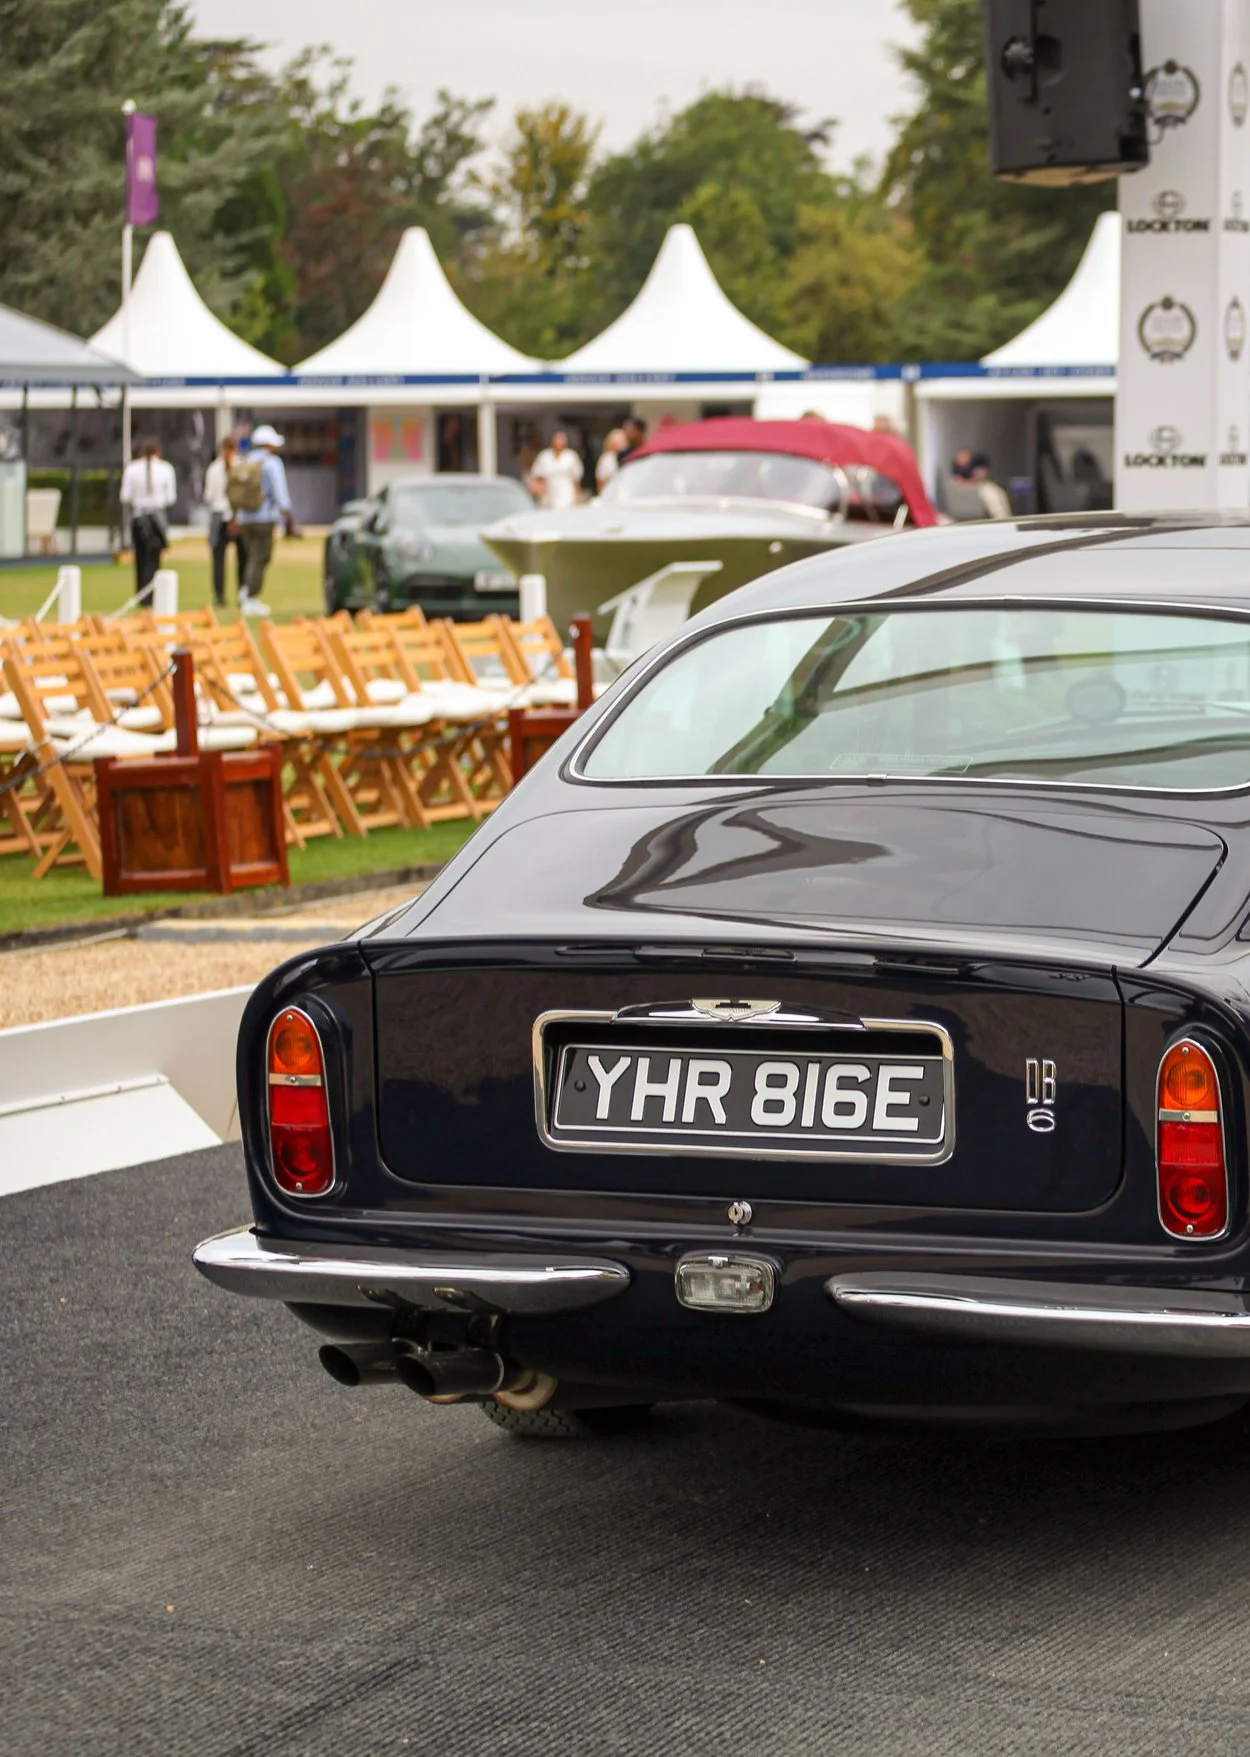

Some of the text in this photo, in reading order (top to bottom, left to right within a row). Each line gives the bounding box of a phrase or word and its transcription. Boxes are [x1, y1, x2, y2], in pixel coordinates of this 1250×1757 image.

[1127, 219, 1210, 233] LOCKTON
[1125, 453, 1206, 467] LOCKTON
[587, 1055, 926, 1131] YHR 816E
[1025, 1058, 1057, 1104] DB
[1026, 1108, 1056, 1132] 6
